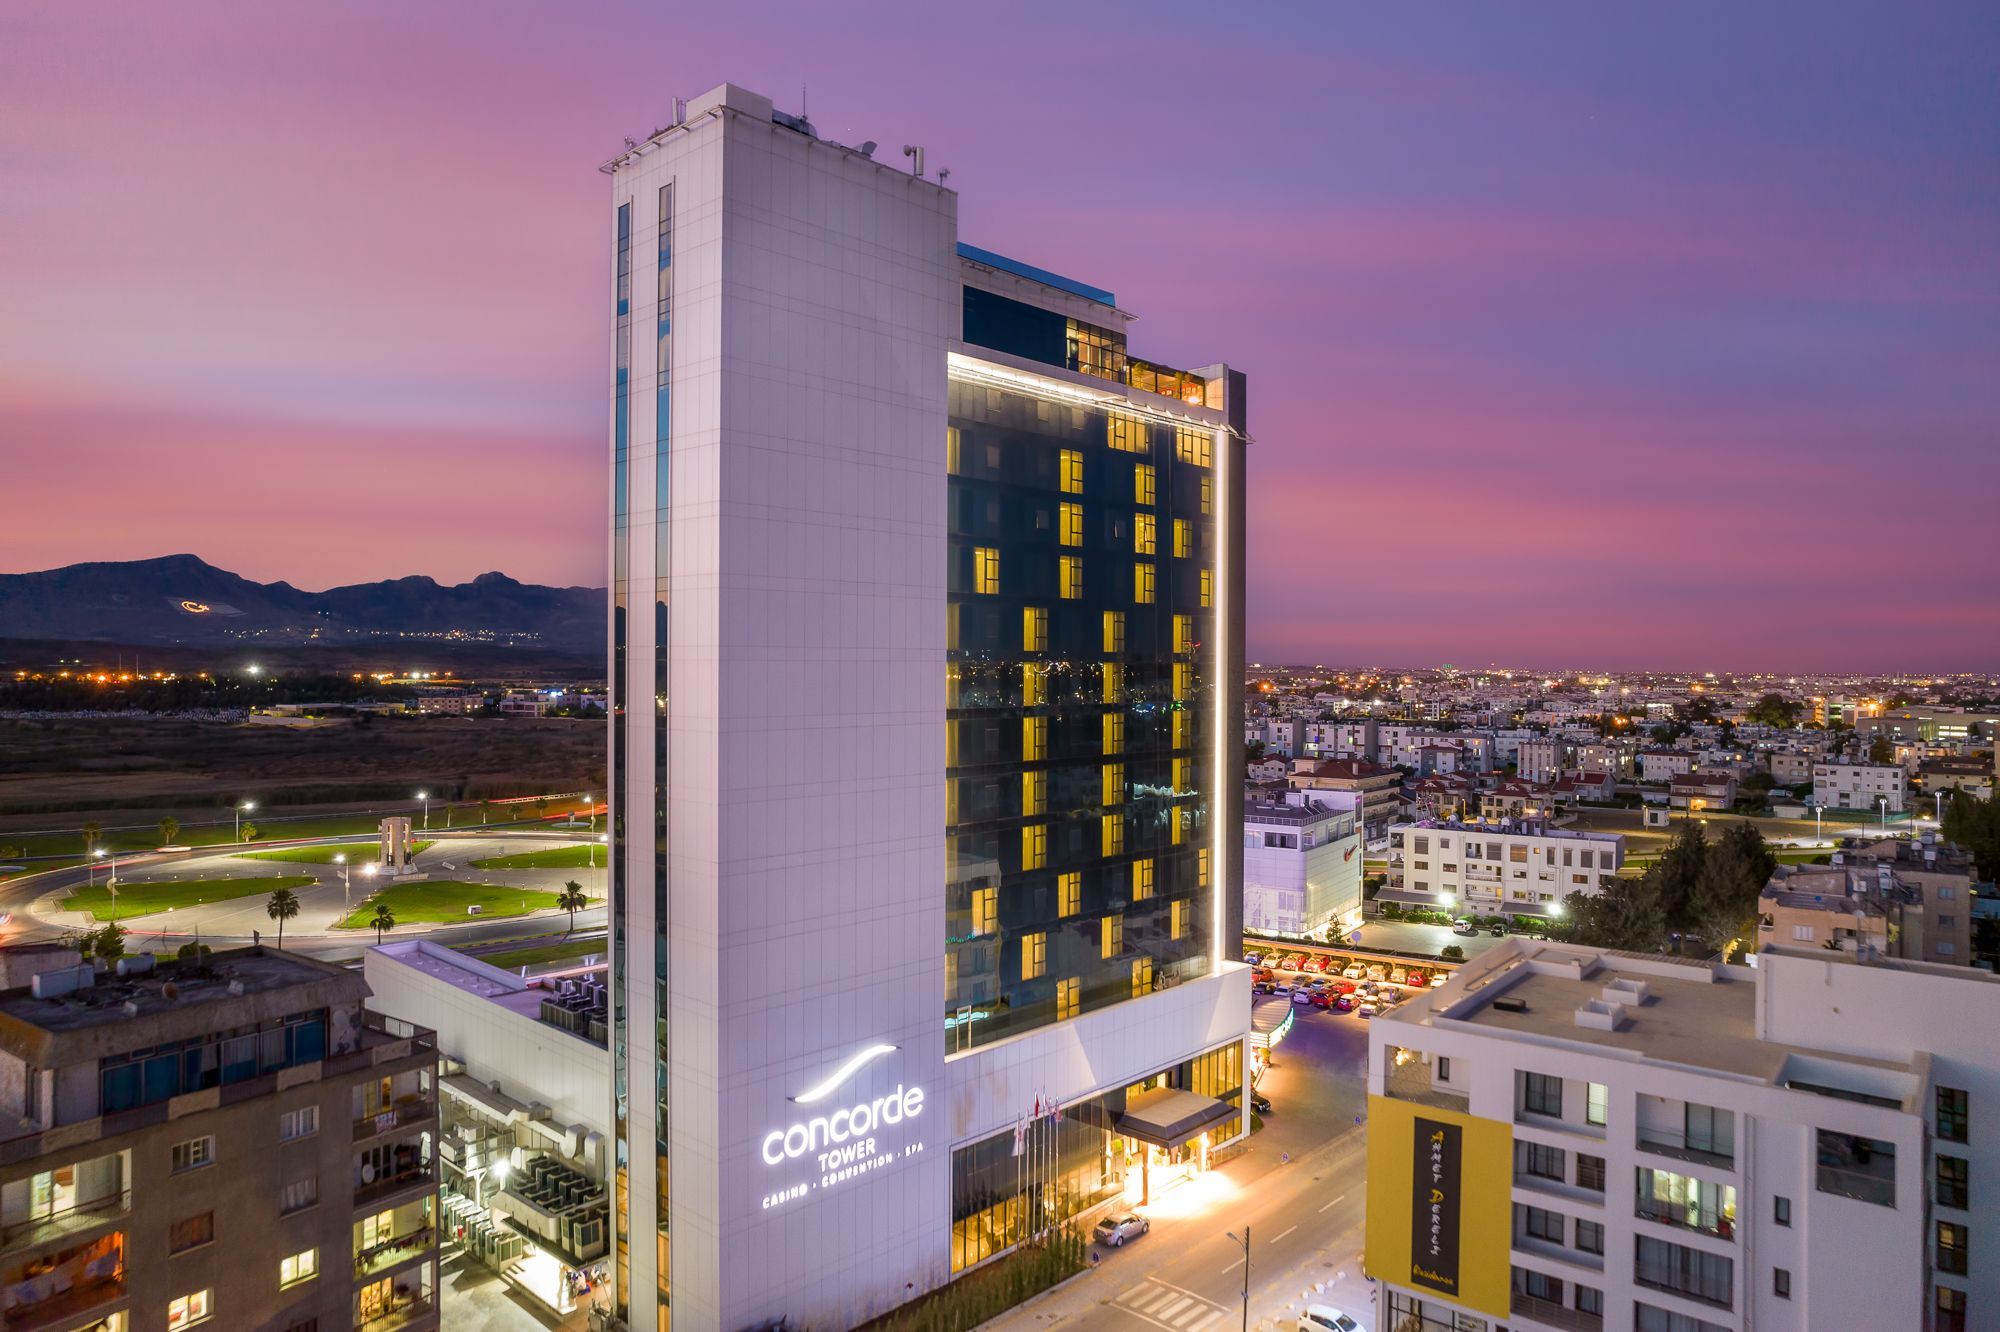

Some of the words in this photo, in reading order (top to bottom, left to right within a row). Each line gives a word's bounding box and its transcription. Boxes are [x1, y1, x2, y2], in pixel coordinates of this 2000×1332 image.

[762, 1084, 924, 1165] concorde
[818, 1138, 876, 1172] TOWER
[762, 1183, 808, 1209] CASINO
[821, 1152, 893, 1188] CONVENTION
[905, 1142, 924, 1157] SPA
